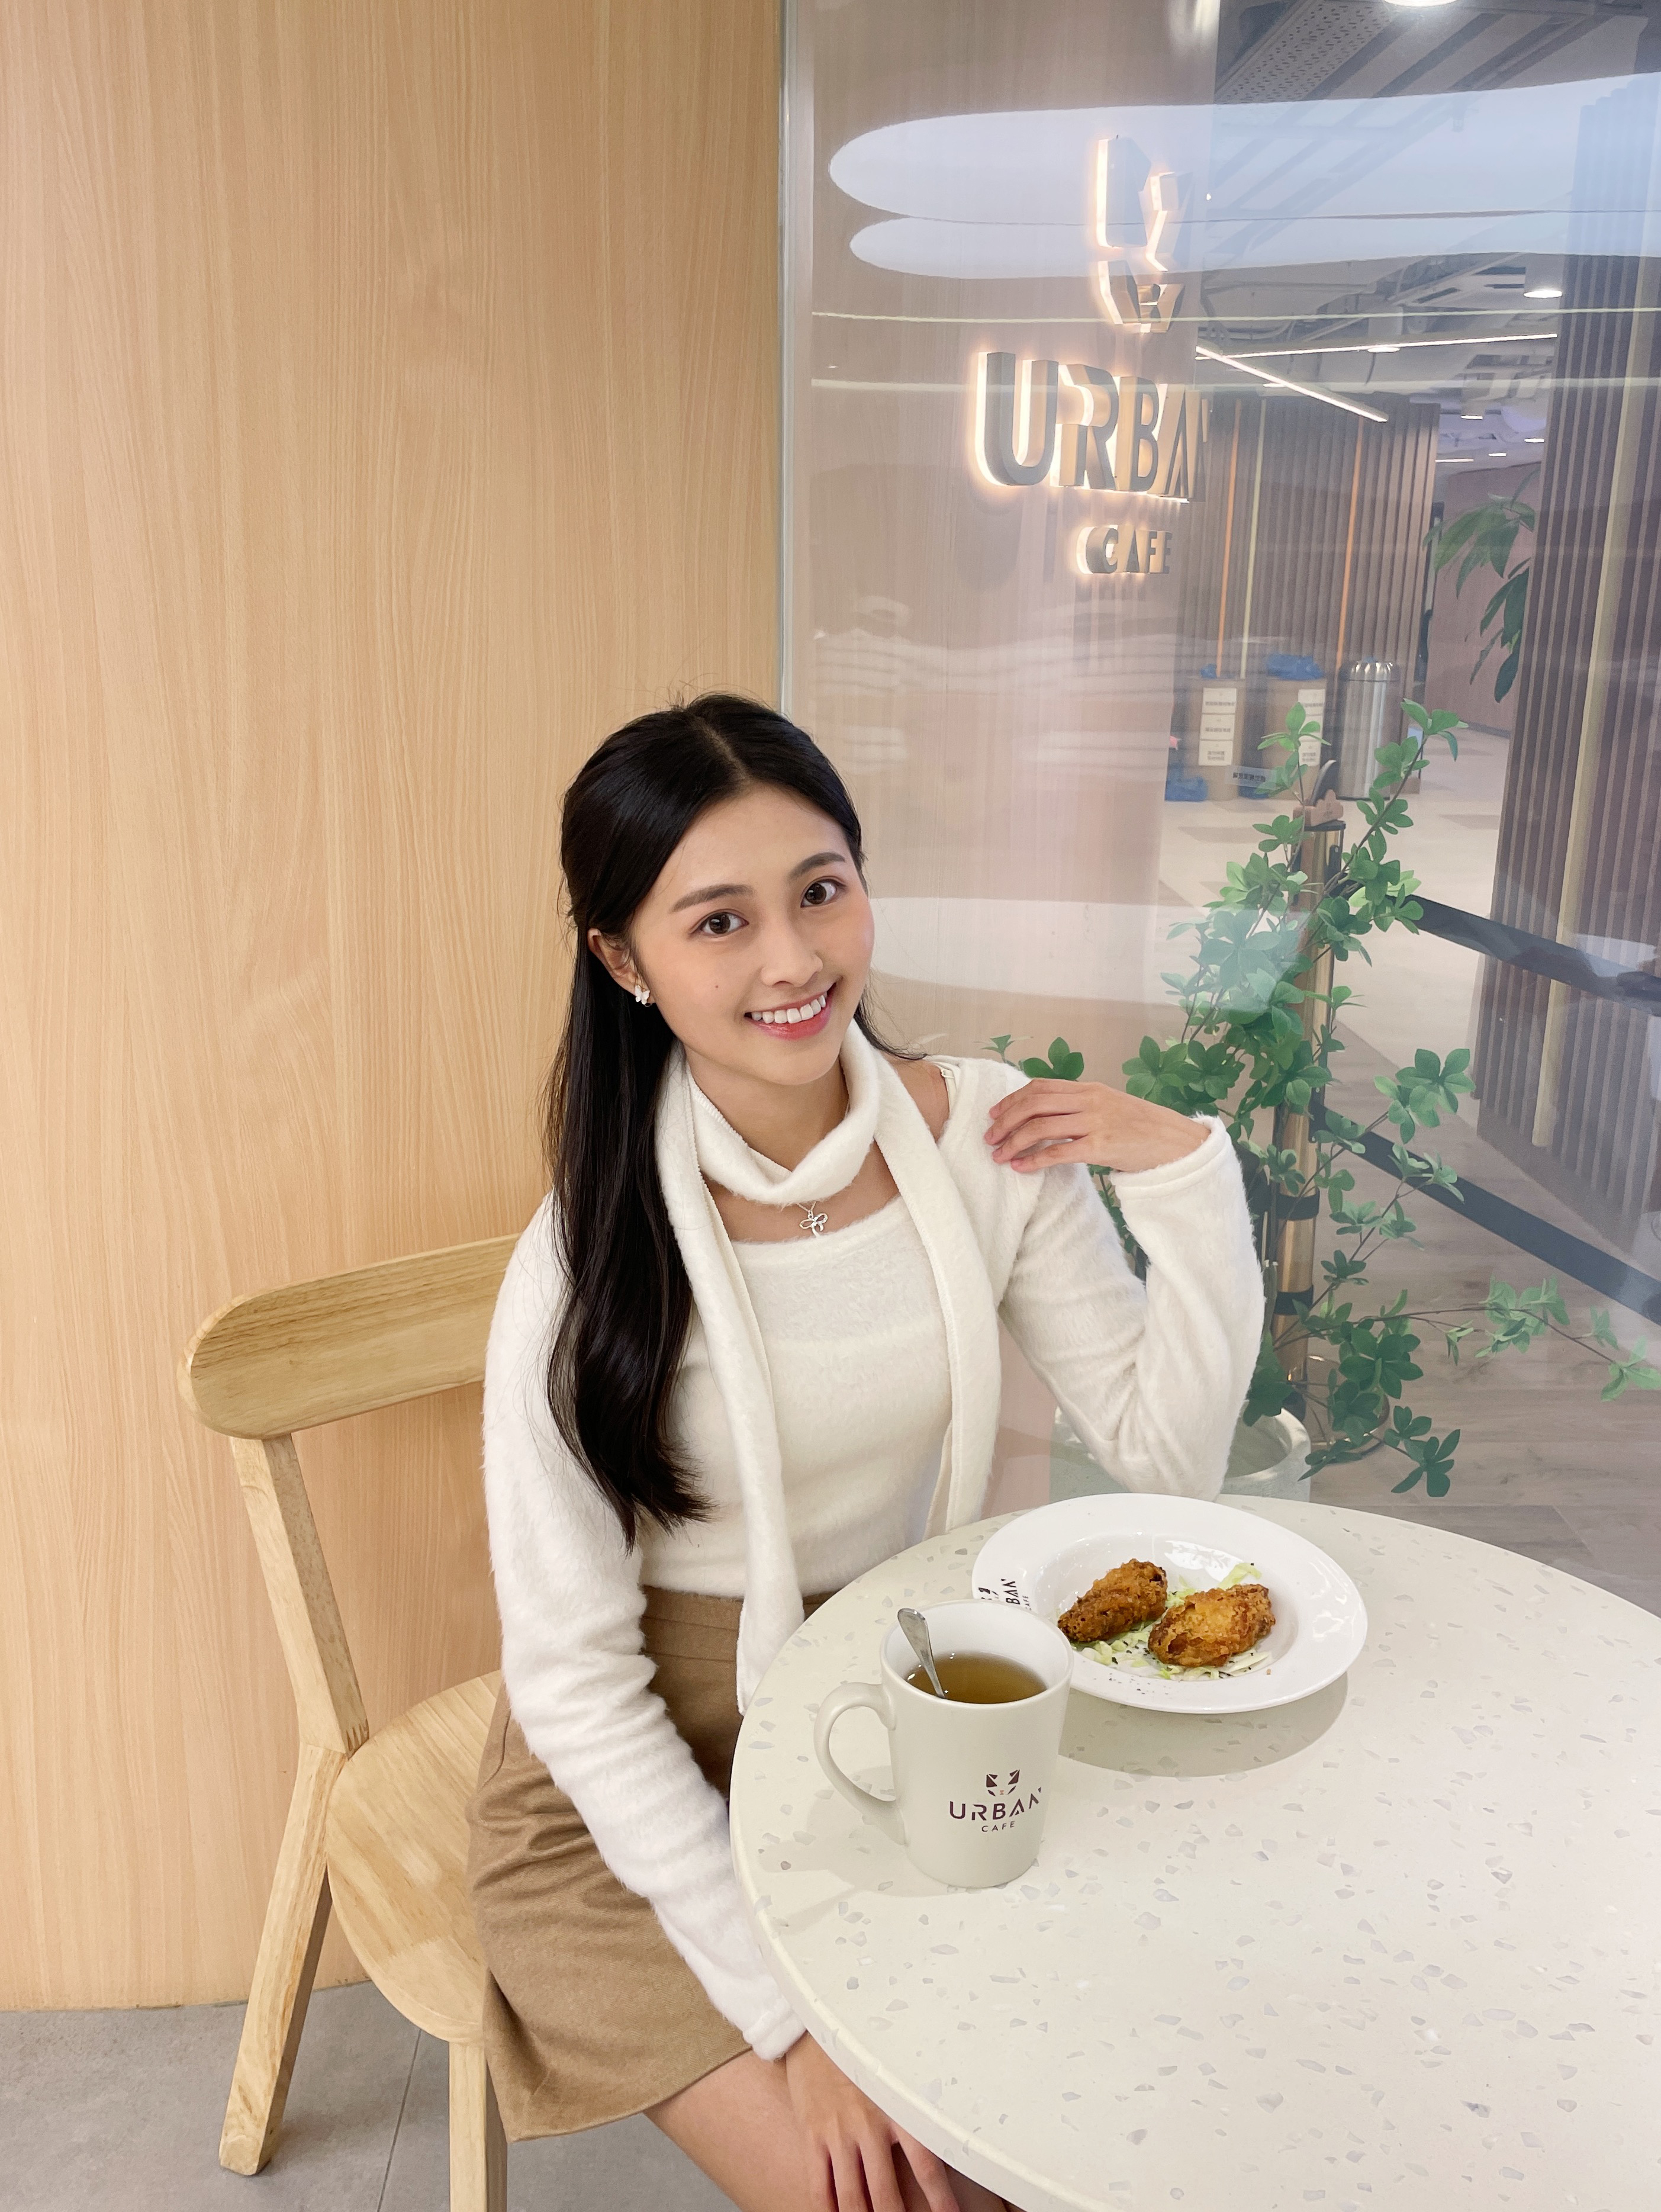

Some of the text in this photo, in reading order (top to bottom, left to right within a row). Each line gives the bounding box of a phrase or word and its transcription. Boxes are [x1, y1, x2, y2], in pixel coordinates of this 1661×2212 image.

[1076, 525, 1173, 574] CAFE
[1000, 1578, 1021, 1605] BAN
[949, 1787, 1042, 1821] URBAN
[981, 1821, 1015, 1832] CAFE
